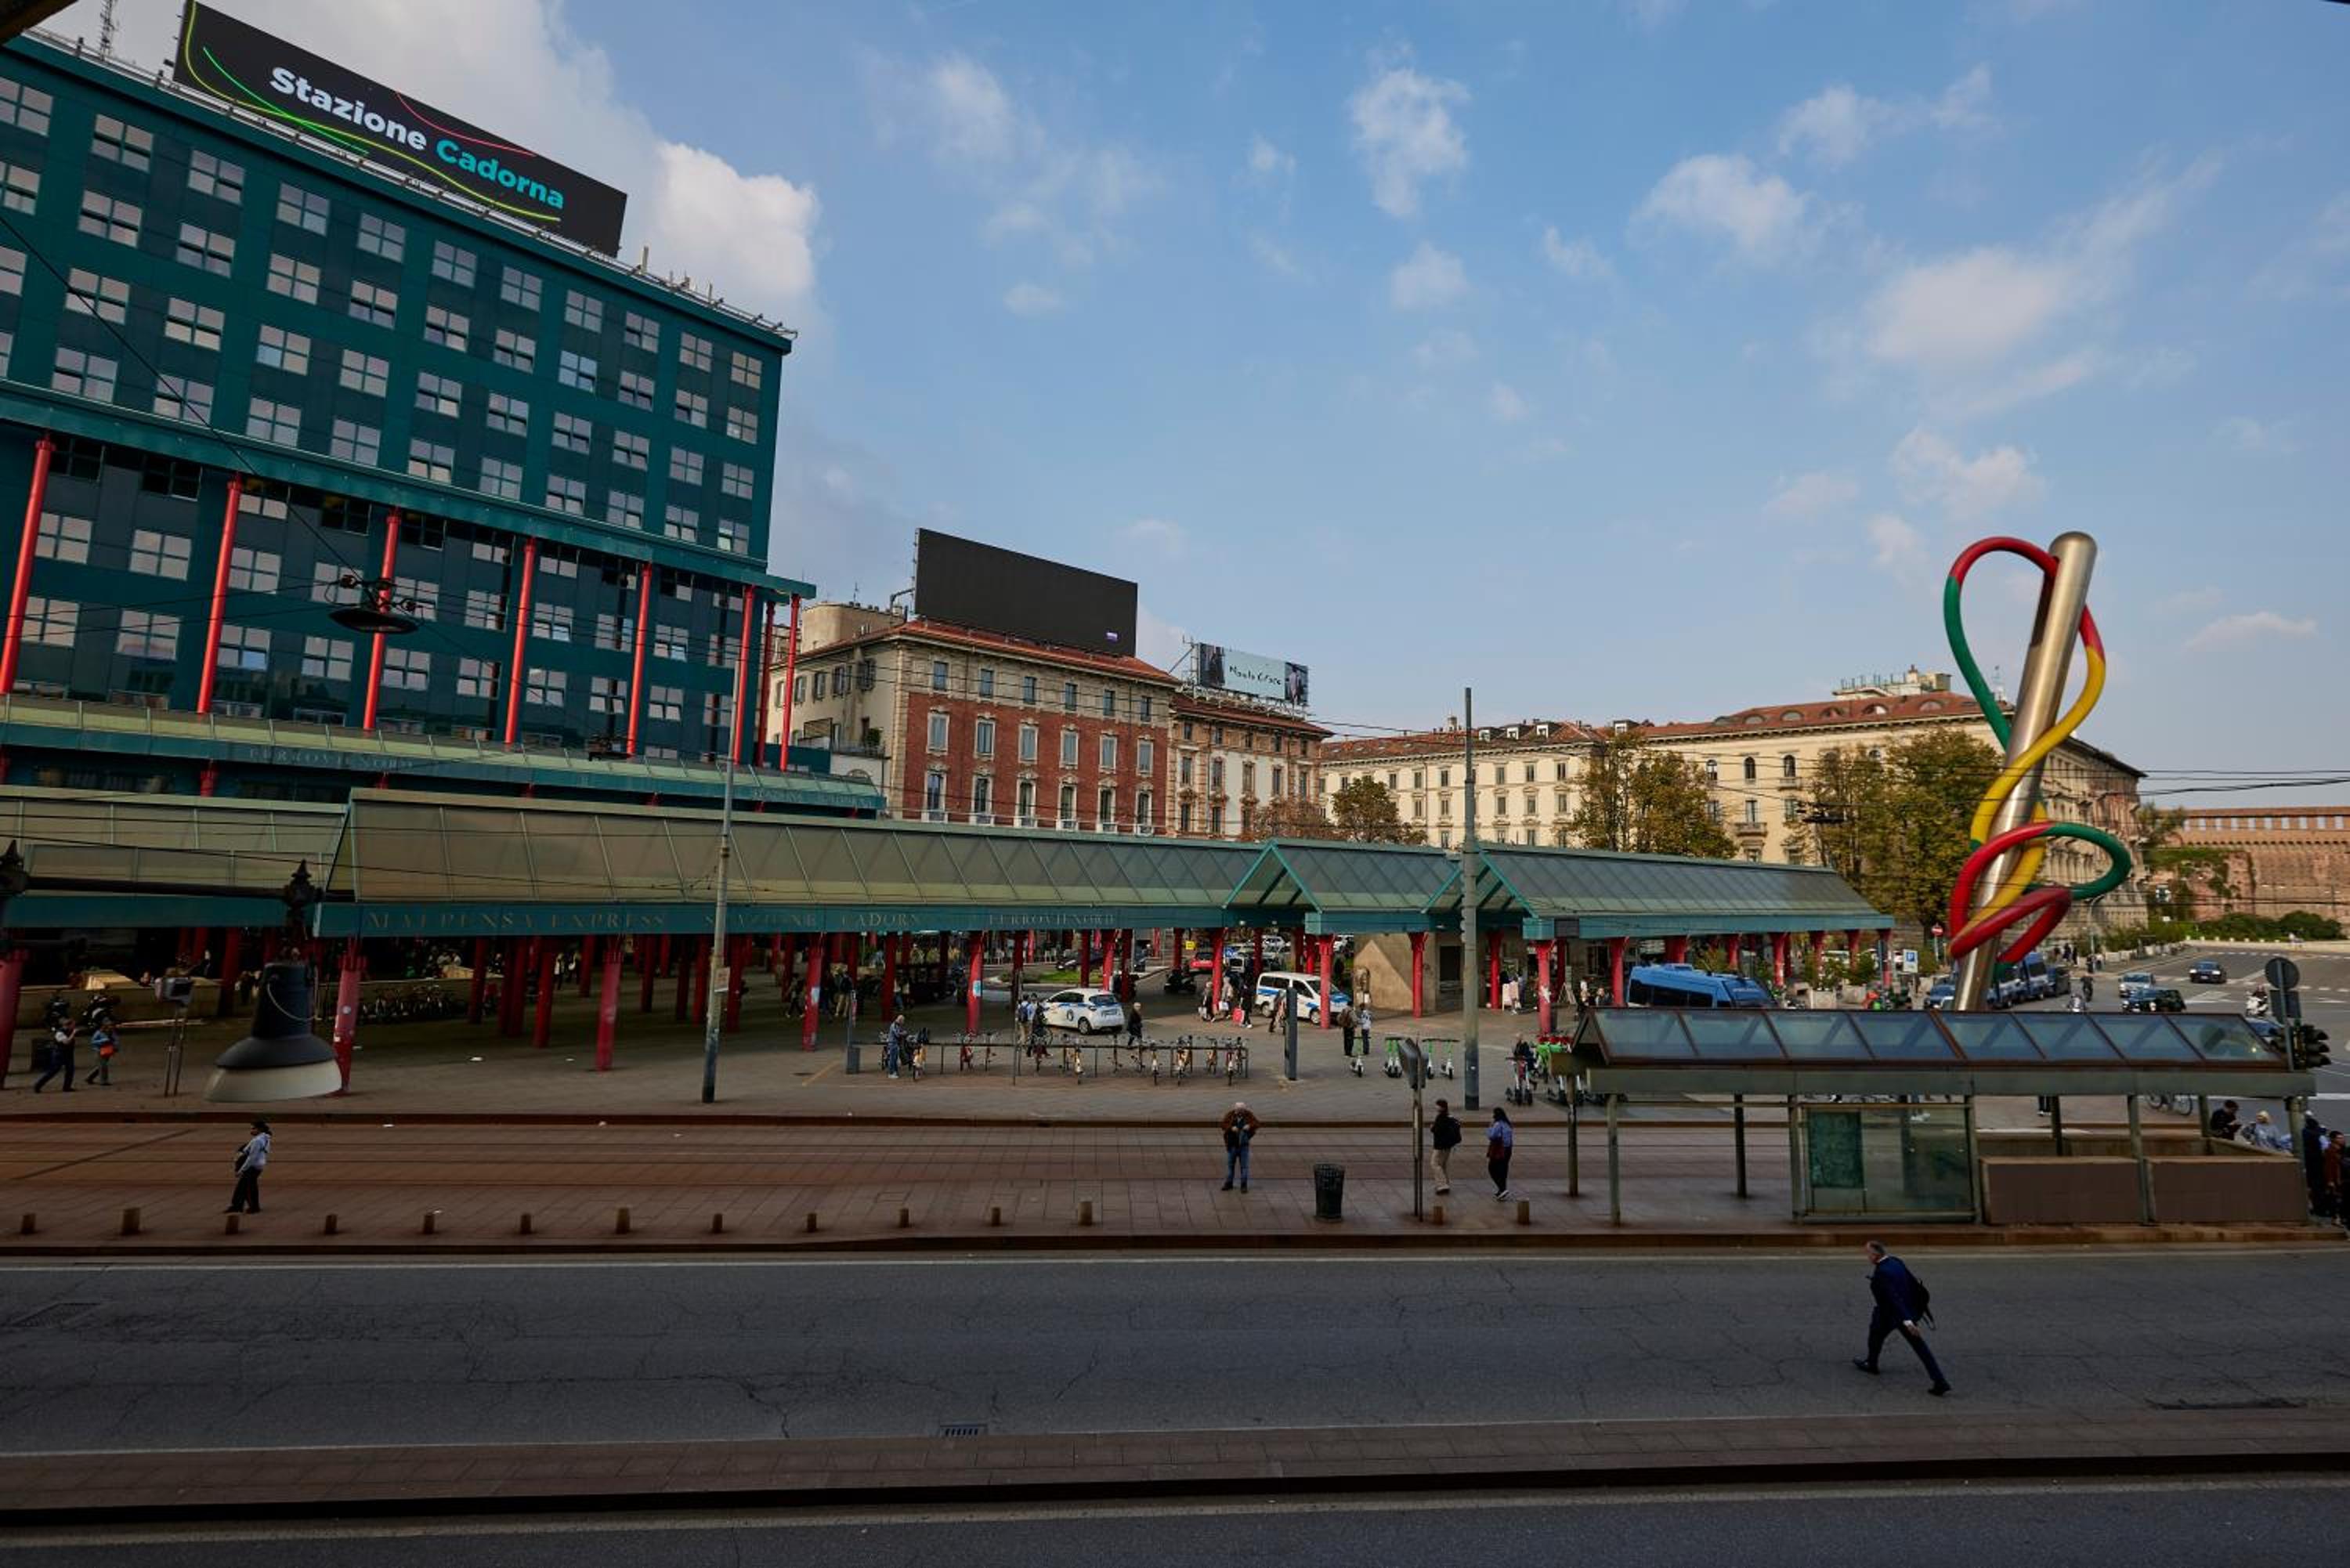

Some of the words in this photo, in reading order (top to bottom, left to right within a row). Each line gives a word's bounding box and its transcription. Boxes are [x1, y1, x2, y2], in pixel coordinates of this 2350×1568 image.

[269, 67, 428, 150] Stazione
[436, 139, 565, 210] Cadorna
[551, 913, 666, 928] EXPRESS
[703, 913, 815, 927] SAZINE
